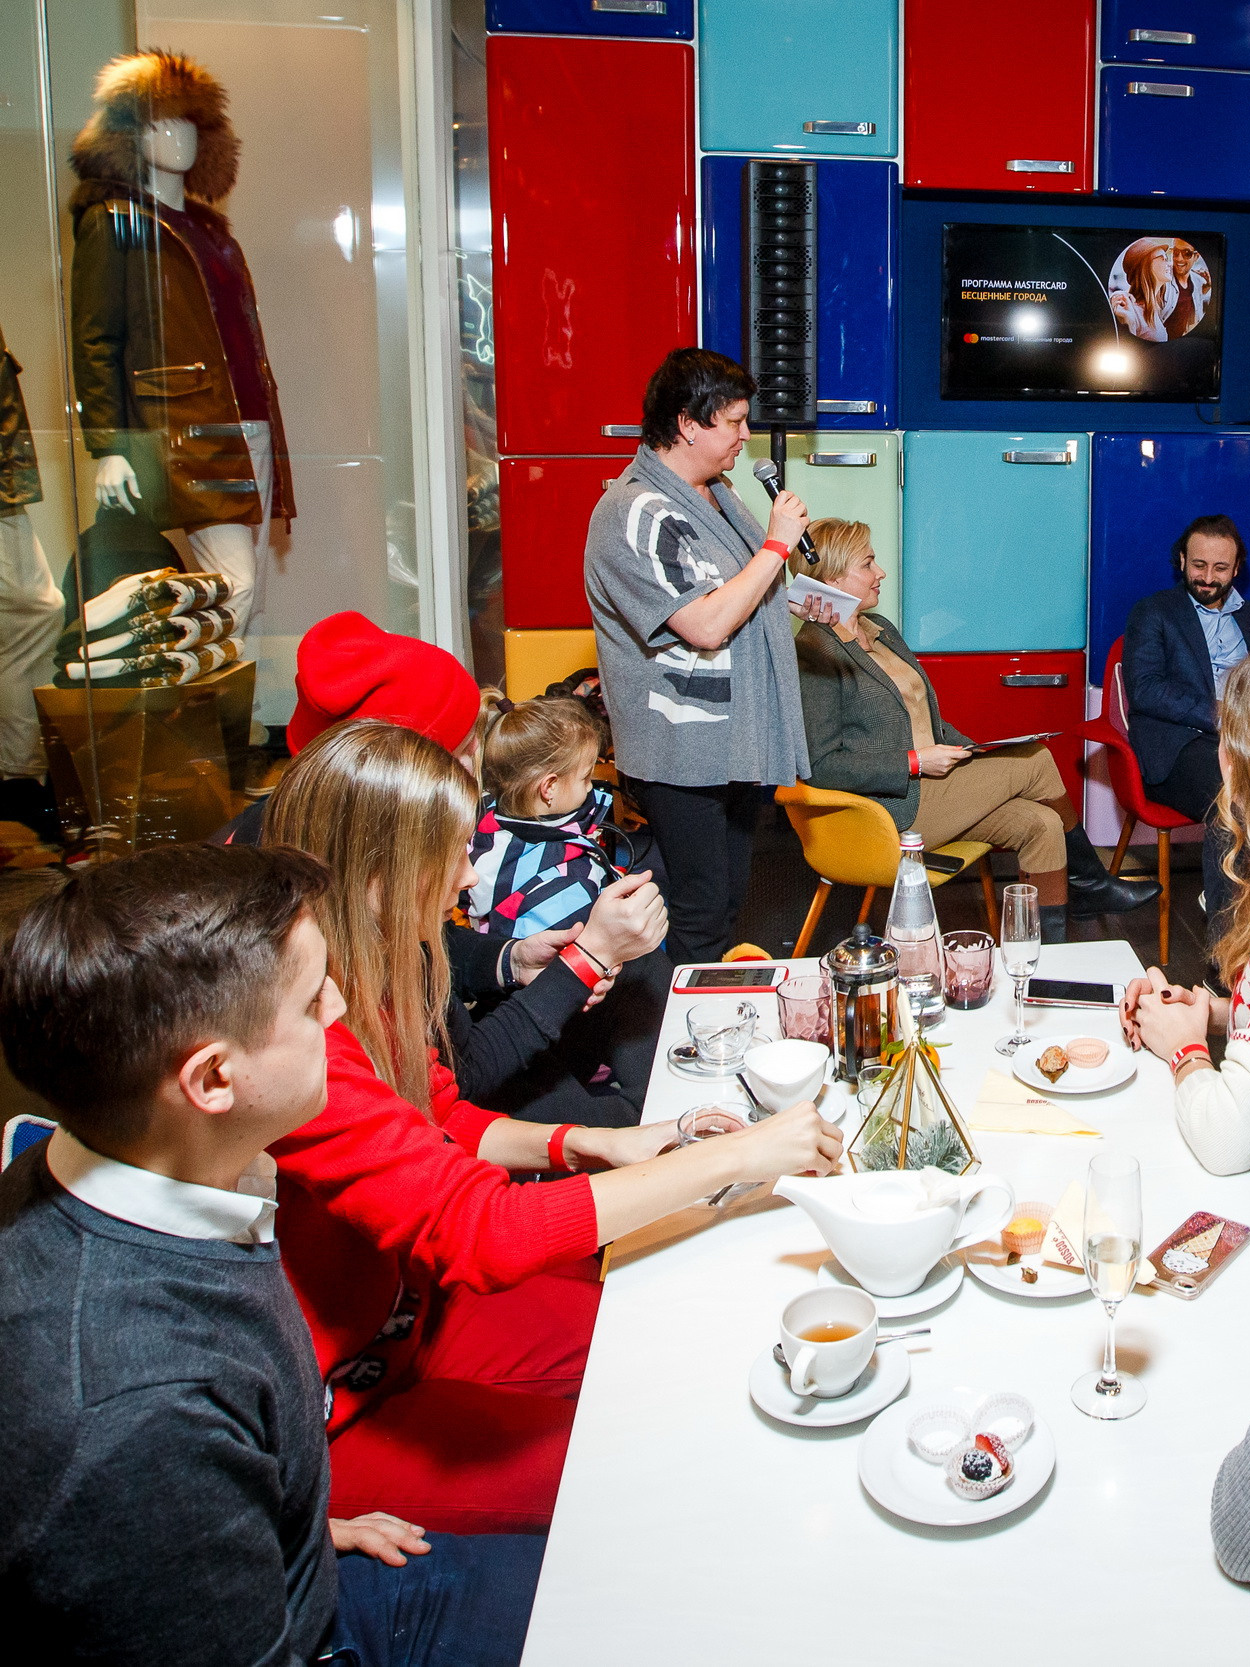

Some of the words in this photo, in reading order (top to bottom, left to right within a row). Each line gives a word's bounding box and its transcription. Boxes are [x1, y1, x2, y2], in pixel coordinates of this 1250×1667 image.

[961, 279, 1013, 289] ПРОГРАММА
[1014, 281, 1067, 290] MASTERCARD
[961, 291, 1012, 302] БЕСЦЕННЫЕ
[1013, 293, 1047, 302] ГОРОДА
[1055, 1240, 1075, 1265] BOSCO
